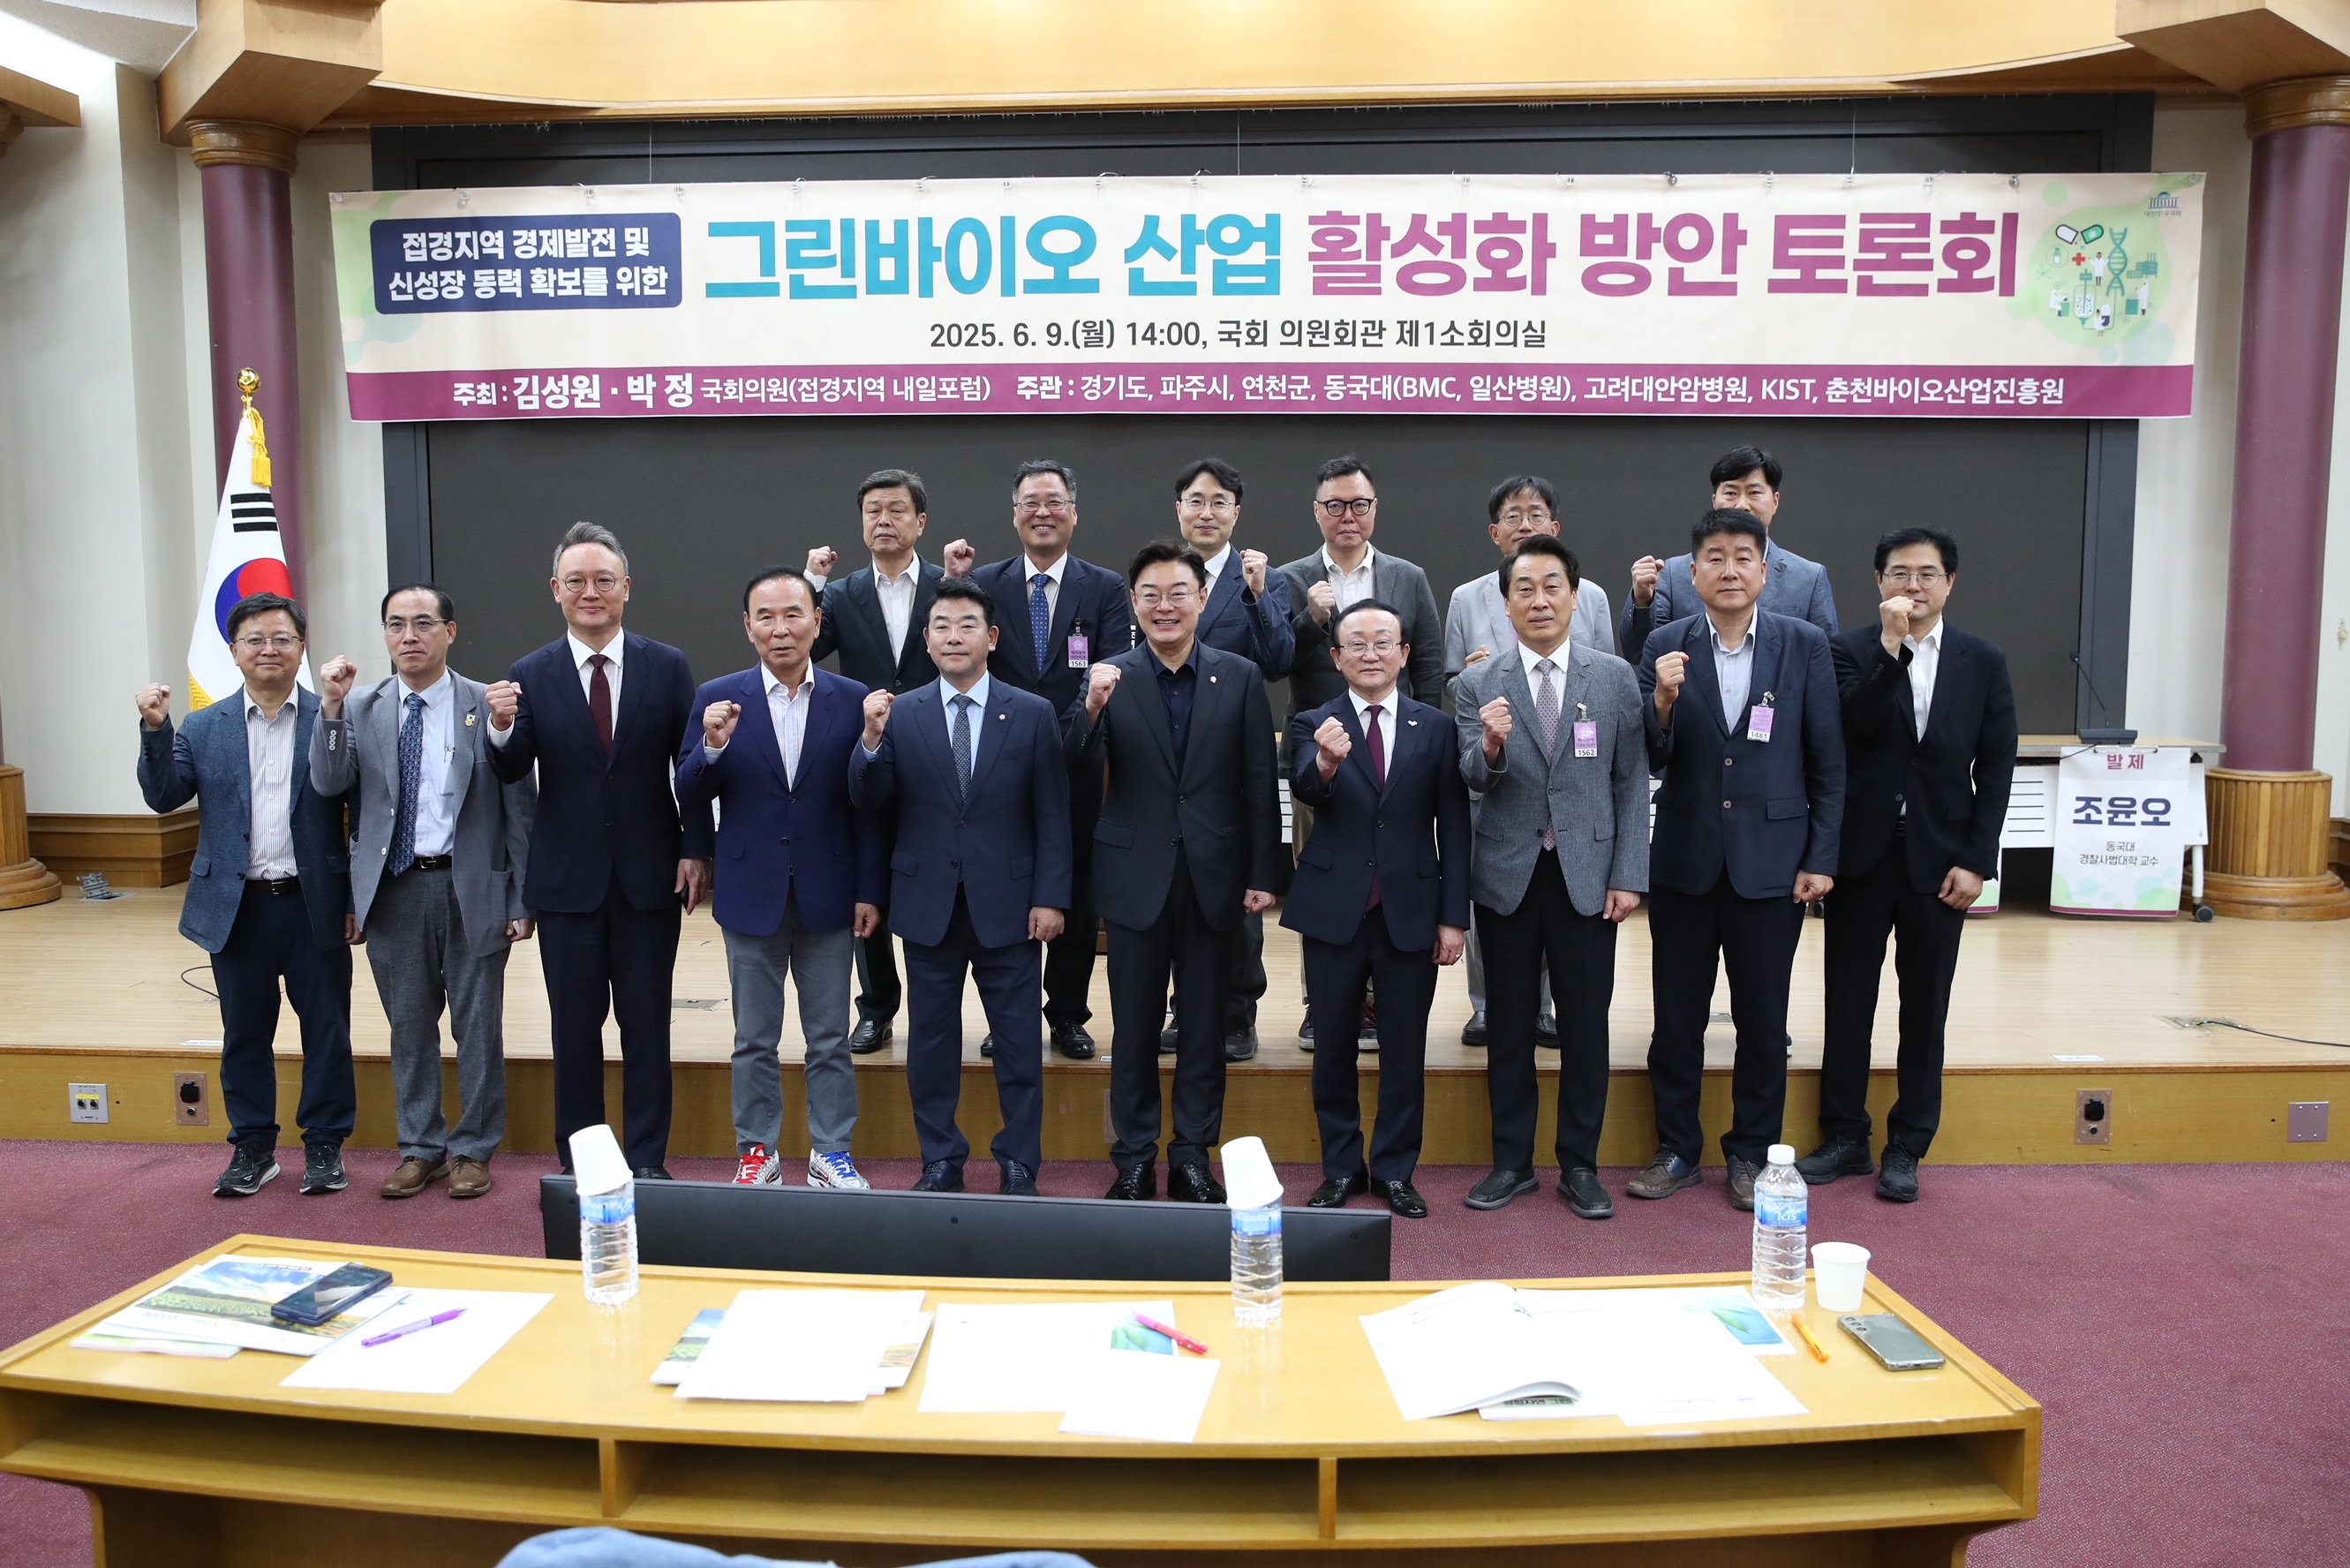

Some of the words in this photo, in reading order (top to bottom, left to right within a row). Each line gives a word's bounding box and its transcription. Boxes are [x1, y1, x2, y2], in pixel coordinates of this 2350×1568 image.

[403, 230, 505, 262] 접경지역
[512, 227, 616, 260] 경제발전
[624, 227, 650, 257] 및
[705, 215, 1101, 300] 그린바이오
[1125, 213, 1282, 297] 산업
[1310, 211, 1555, 296] 활성화
[1581, 214, 1747, 297] 방안
[1769, 213, 2018, 297] 토론회
[388, 269, 466, 301] 신성장
[473, 268, 523, 299] 동력
[530, 267, 609, 298] 확보를
[615, 265, 668, 296] 위한
[930, 323, 1004, 348] 2025.
[1013, 322, 1036, 347] 6.
[1126, 321, 1208, 350] 14:00,
[1217, 319, 1268, 348] 국회
[1279, 319, 1387, 348] 의원회관
[1396, 319, 1546, 348] 제1소회의실
[512, 373, 601, 411] 김성원
[893, 375, 991, 403] 내일포럼)
[1081, 374, 1154, 402] 경기도,
[1160, 374, 1235, 402] 파주시,
[1242, 374, 1315, 401] 연천군,
[1323, 374, 1462, 402] 동국대(BMC,
[1469, 374, 1577, 403] 일산병원),
[1583, 375, 1753, 403] 고려대안암병원,
[1761, 378, 1819, 404] KIST,
[1825, 376, 2064, 405] 춘천바이오산업진흥원
[2073, 796, 2171, 826] 조윤오
[2079, 854, 2138, 866] 경찰사법대학
[2140, 856, 2158, 866] 교수
[2105, 841, 2135, 852] 동국대
